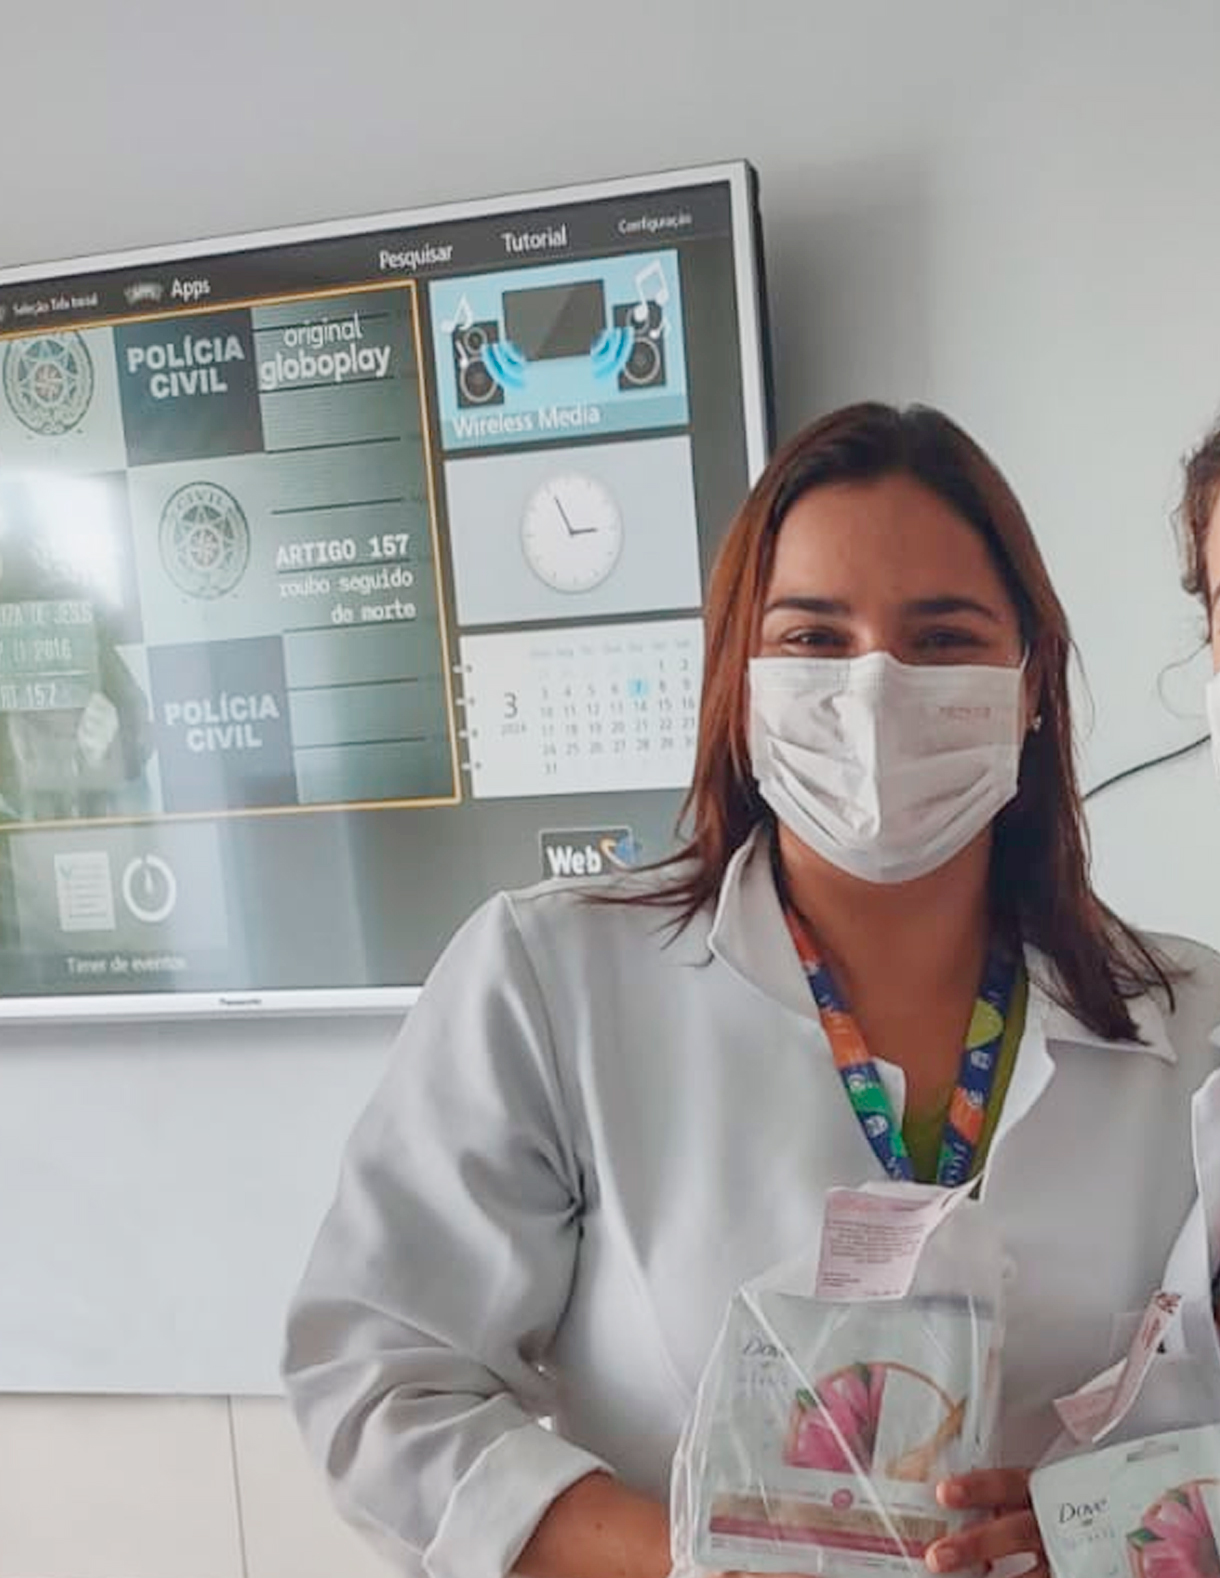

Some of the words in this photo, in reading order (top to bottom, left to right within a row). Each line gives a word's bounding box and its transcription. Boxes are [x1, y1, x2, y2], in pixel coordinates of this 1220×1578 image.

[502, 225, 568, 253] Tutorial
[379, 243, 454, 271] Pesquisar
[171, 279, 211, 301] Apps
[283, 314, 363, 350] original
[126, 334, 245, 374] POLÍCIA
[258, 343, 391, 392] globoplay
[149, 367, 228, 399] CIVIL
[452, 411, 534, 440] Wireless
[538, 404, 601, 429] Media
[276, 539, 357, 567] ARTIGO
[368, 533, 410, 558] 157
[279, 577, 331, 597] roubo
[338, 567, 414, 594] seguido
[163, 691, 280, 726] POLÍCIA
[503, 691, 519, 719] 3
[186, 723, 263, 752] CIVIL
[546, 844, 602, 875] Web
[1059, 1498, 1107, 1524] Dove
